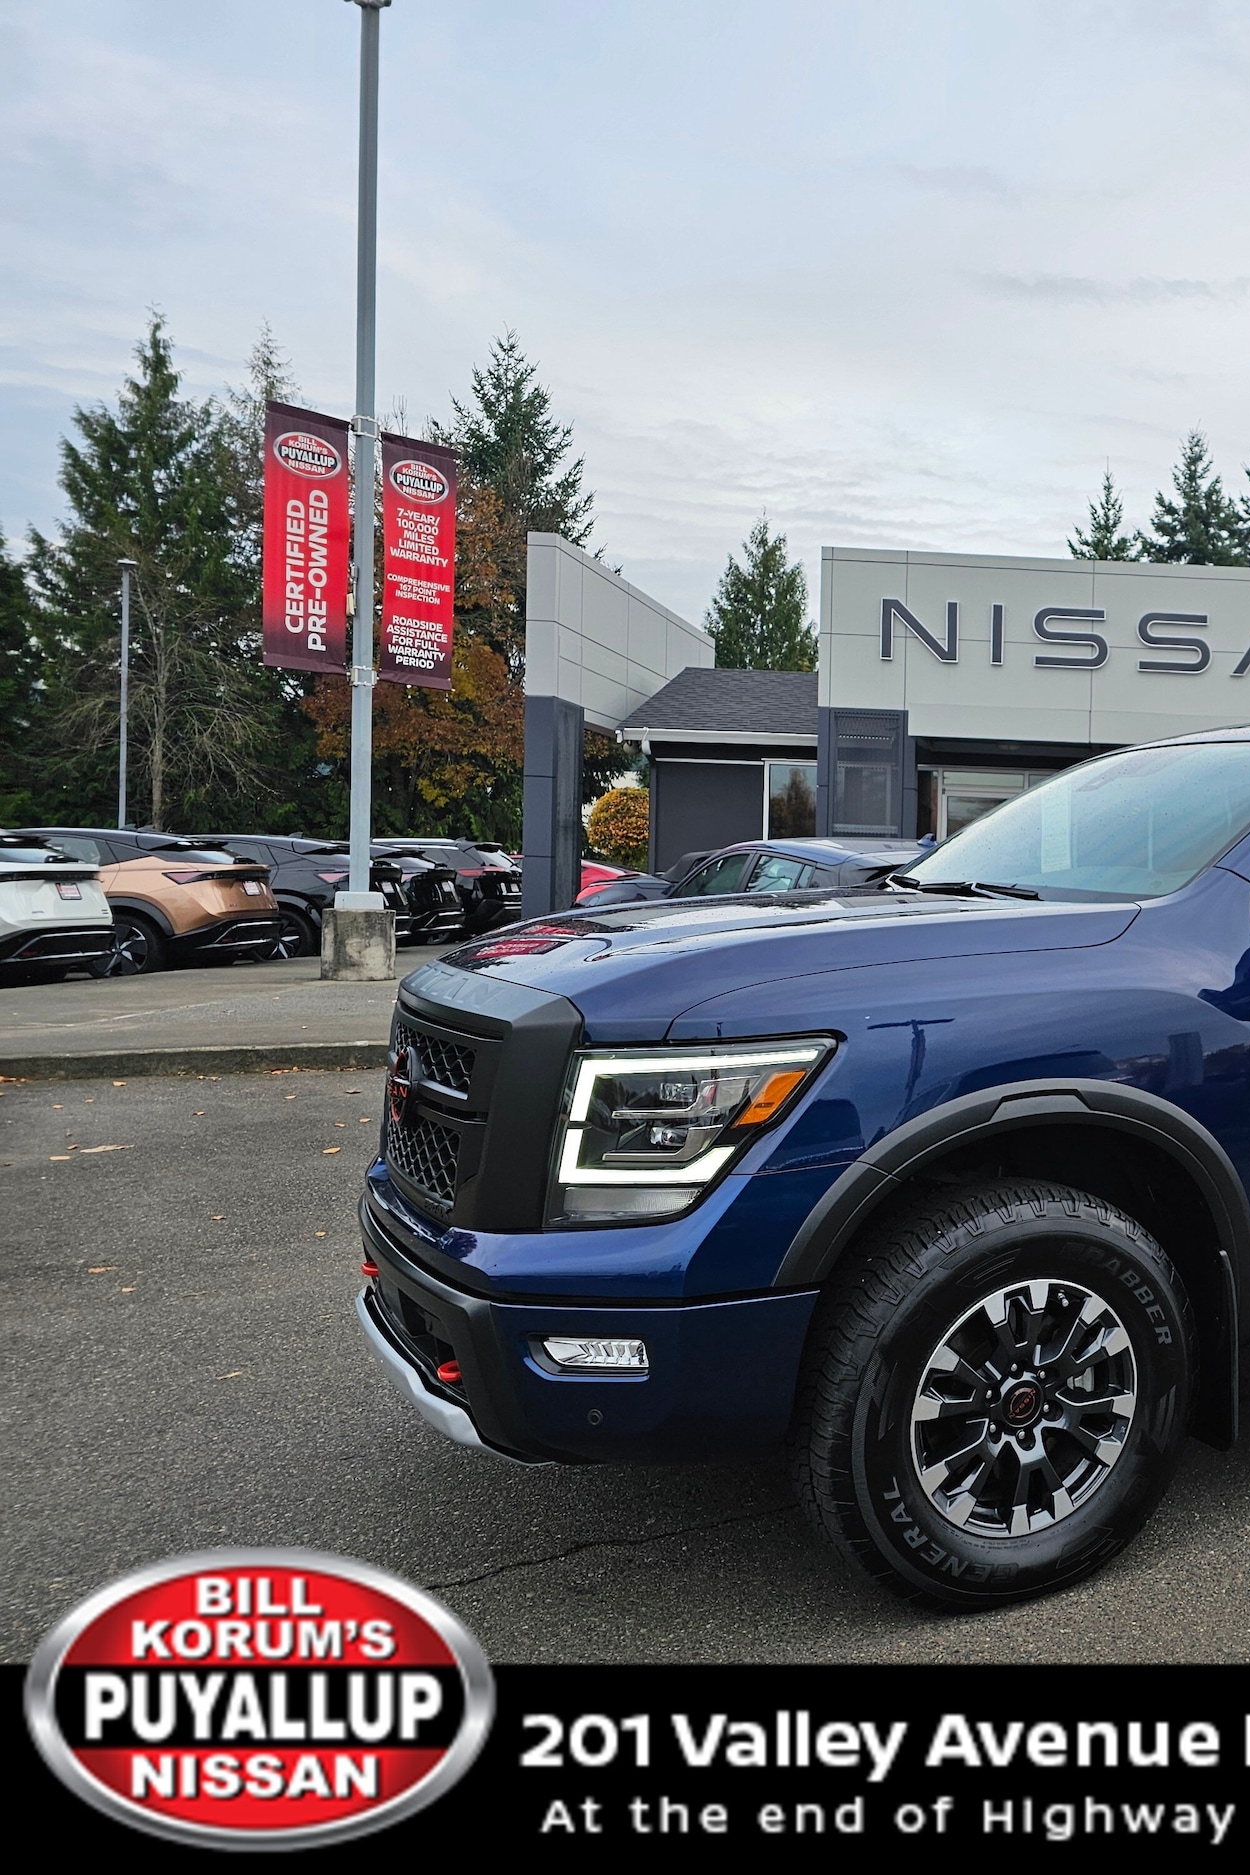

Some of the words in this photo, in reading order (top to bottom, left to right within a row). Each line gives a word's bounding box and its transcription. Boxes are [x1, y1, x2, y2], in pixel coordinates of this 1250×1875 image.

[297, 435, 317, 446] BILL
[281, 445, 336, 468] PUYALLUP
[288, 459, 326, 475] NISSAN
[410, 463, 428, 474] BILL
[396, 472, 443, 494] PUYALLUP
[402, 485, 435, 500] NISSAN
[397, 507, 440, 526] 7-YEAR/
[396, 518, 439, 536] 100,000
[403, 529, 435, 545] MILES
[398, 538, 440, 556] LIMITED
[389, 546, 449, 568] WARRANTY
[285, 499, 305, 634] CERTIFIED
[307, 489, 329, 652] PRE-OWNED
[387, 573, 450, 593] COMPREHENSIVE
[399, 583, 412, 592] 167
[412, 586, 437, 597] POINT
[395, 589, 441, 605] INSPECTION
[392, 614, 444, 633] ROADSIDE
[386, 624, 448, 643] ASSISTANCE
[392, 634, 414, 648] FOR
[414, 638, 440, 651] FULL
[387, 643, 446, 662] WARRANTY
[395, 655, 435, 670] PERIOD
[882, 1475, 1021, 1584] GENERAL
